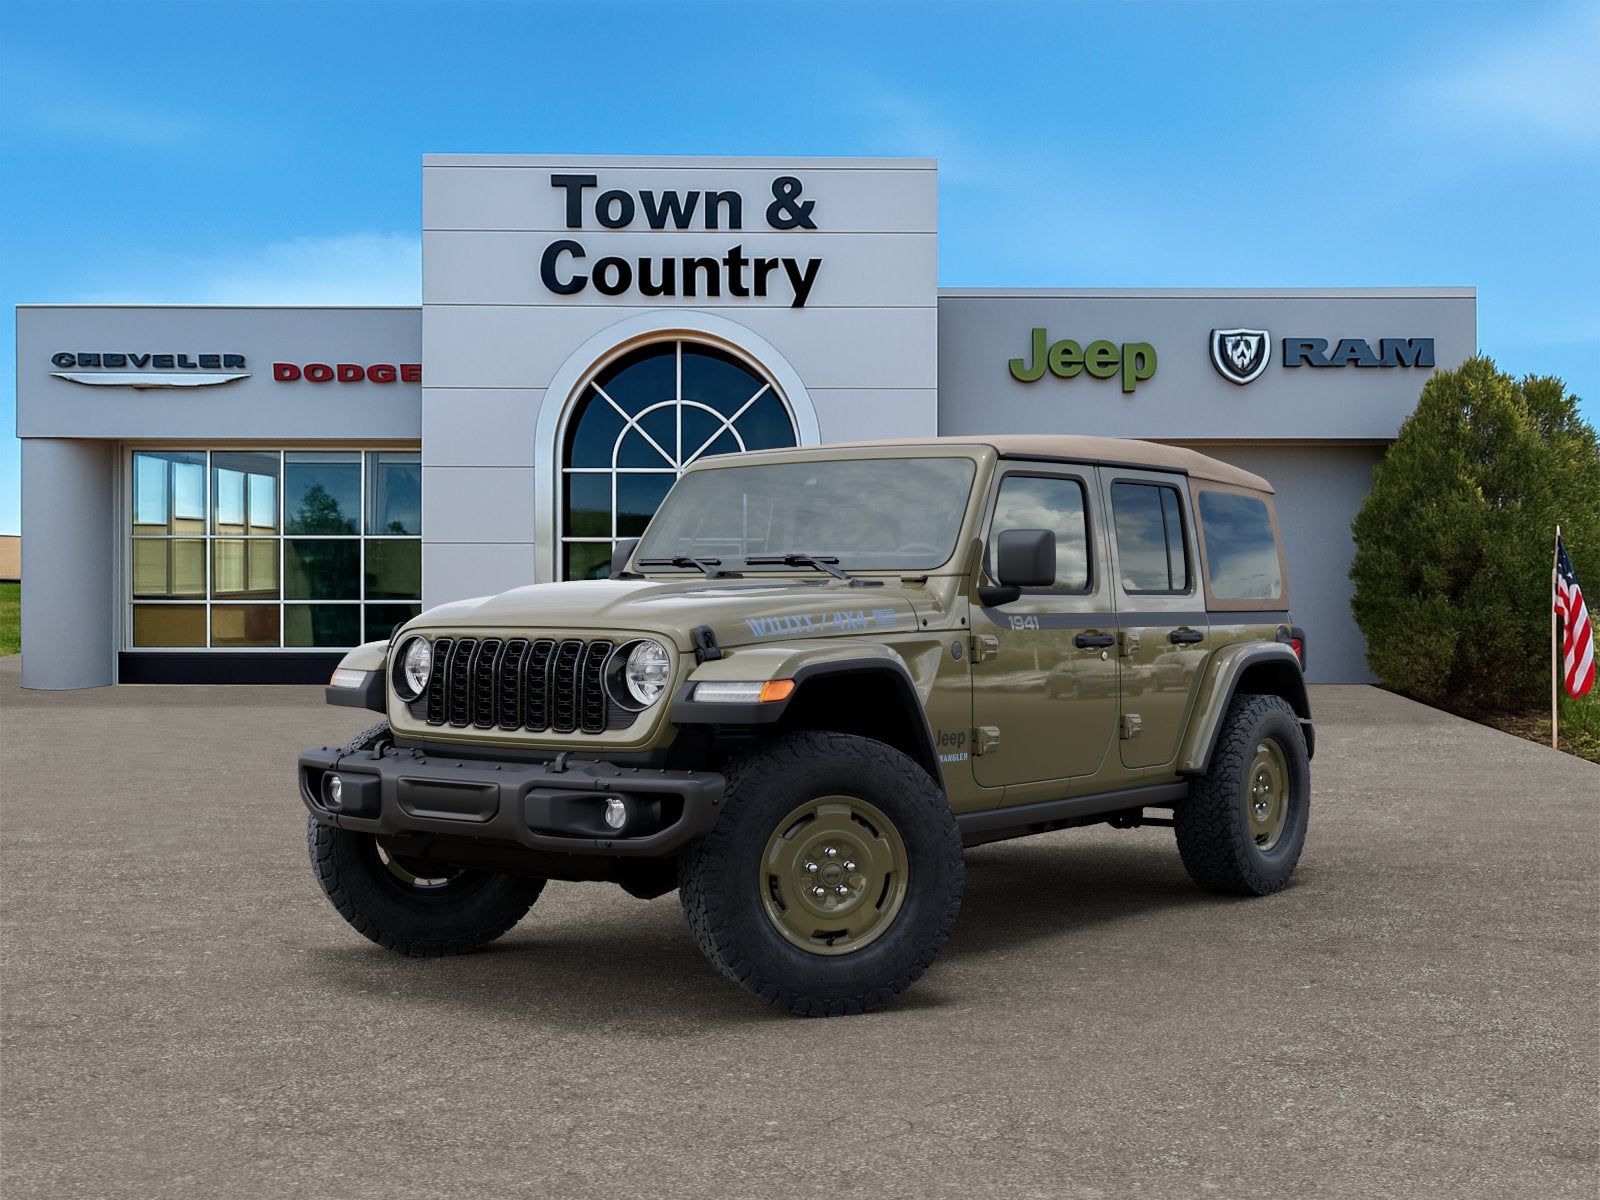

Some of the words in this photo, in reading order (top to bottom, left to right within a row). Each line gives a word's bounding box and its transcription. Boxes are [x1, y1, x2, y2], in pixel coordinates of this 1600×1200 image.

[550, 174, 743, 230] Town
[765, 176, 818, 230] &
[540, 239, 822, 308] Country
[1008, 327, 1158, 393] Jeep
[1282, 337, 1435, 368] RAM
[272, 363, 422, 384] DODGE
[1007, 615, 1040, 631] 1941
[935, 728, 966, 749] Jeep
